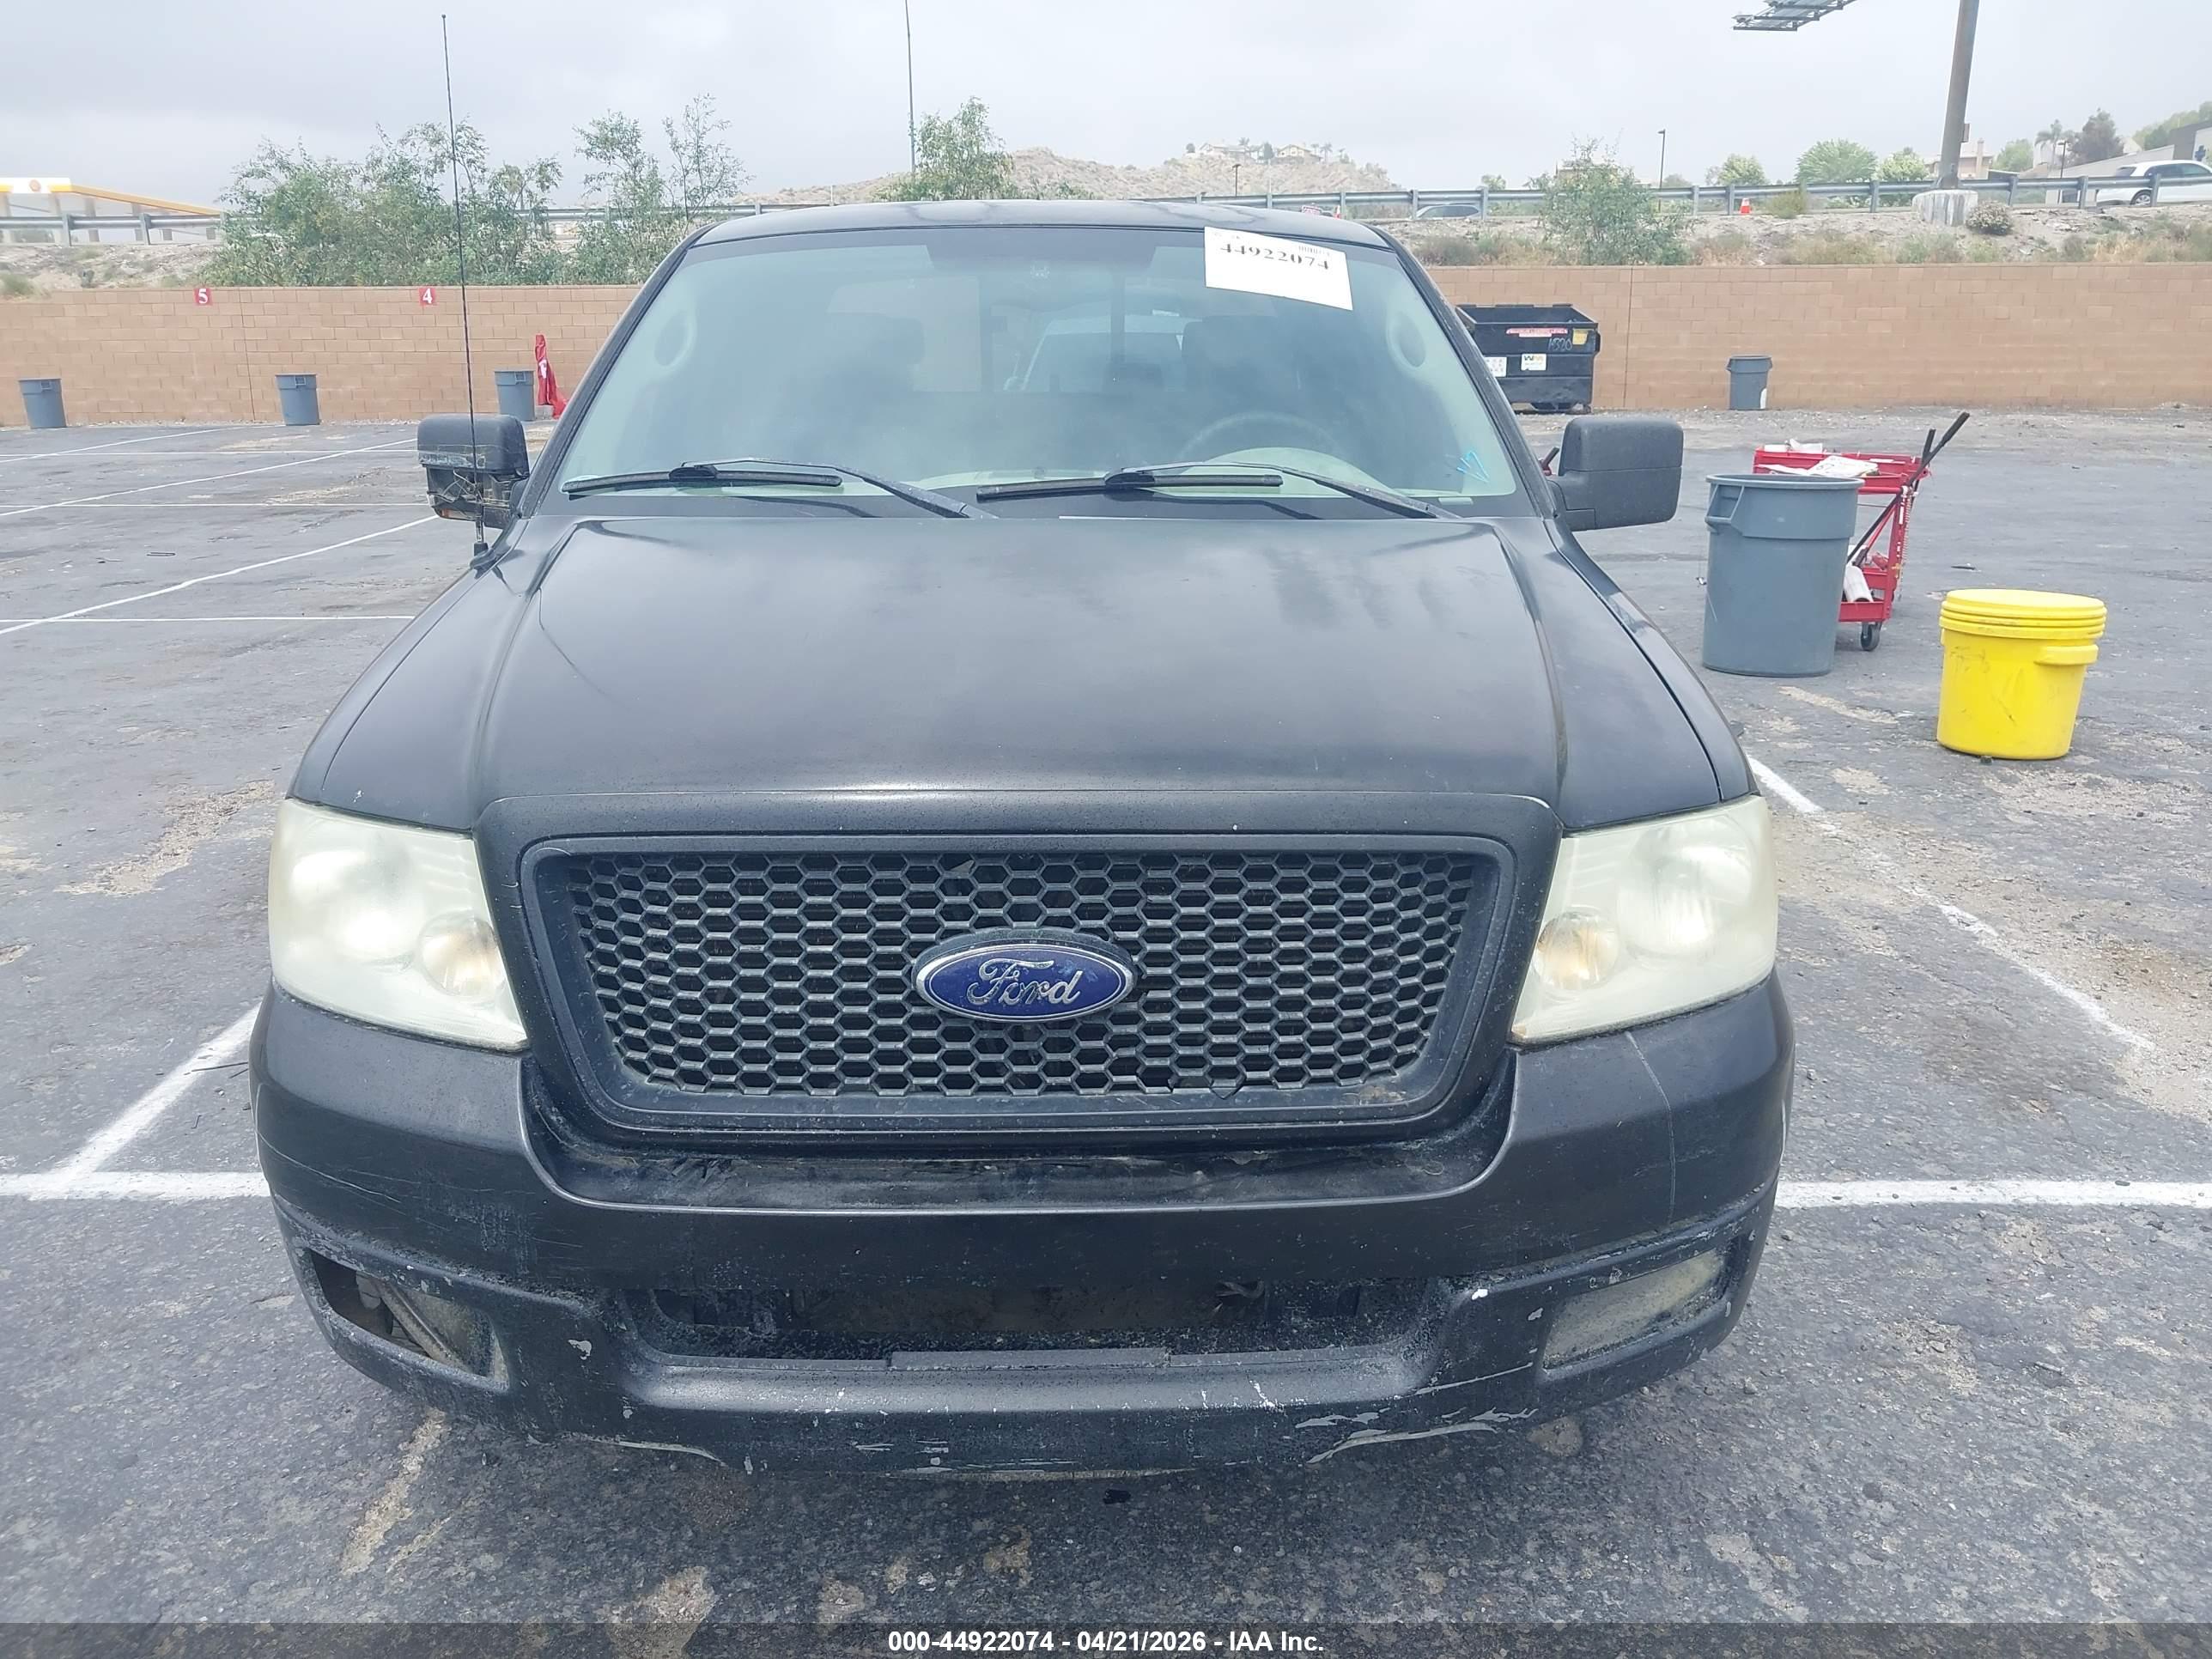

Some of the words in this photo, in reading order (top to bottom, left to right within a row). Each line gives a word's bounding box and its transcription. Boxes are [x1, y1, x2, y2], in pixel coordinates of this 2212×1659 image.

[1220, 243, 1329, 270] 44922074
[198, 288, 209, 304] 5
[422, 288, 433, 304] 4
[967, 957, 1084, 1006] Ford
